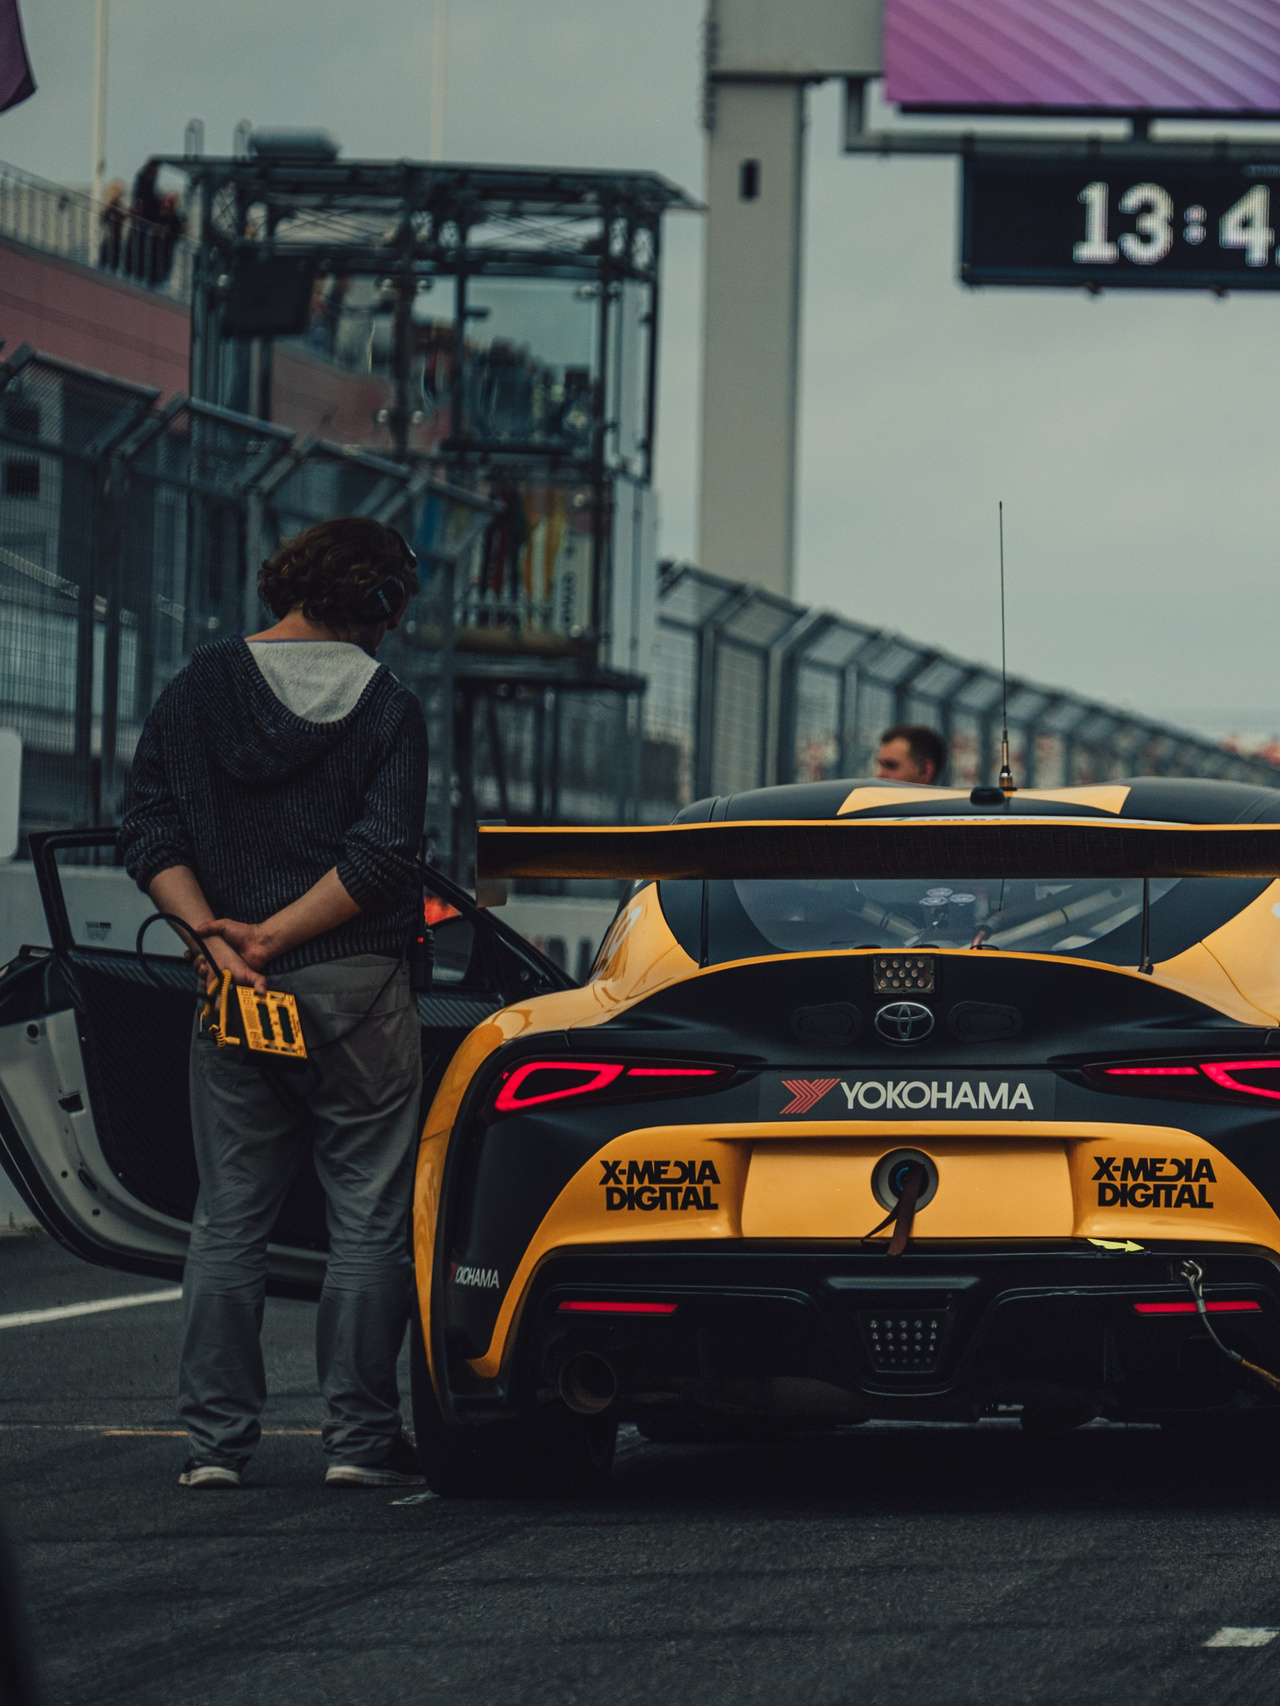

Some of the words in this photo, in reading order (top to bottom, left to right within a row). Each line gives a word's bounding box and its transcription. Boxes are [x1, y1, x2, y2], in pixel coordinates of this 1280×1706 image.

[840, 1081, 1034, 1110] YOKOHAMA
[599, 1160, 721, 1185] X-MEDIA
[1091, 1156, 1217, 1183] X-MEDIA
[606, 1186, 719, 1211] DIGITAL
[1098, 1183, 1214, 1208] DIGITAL
[454, 1265, 500, 1289] OOHAMA
